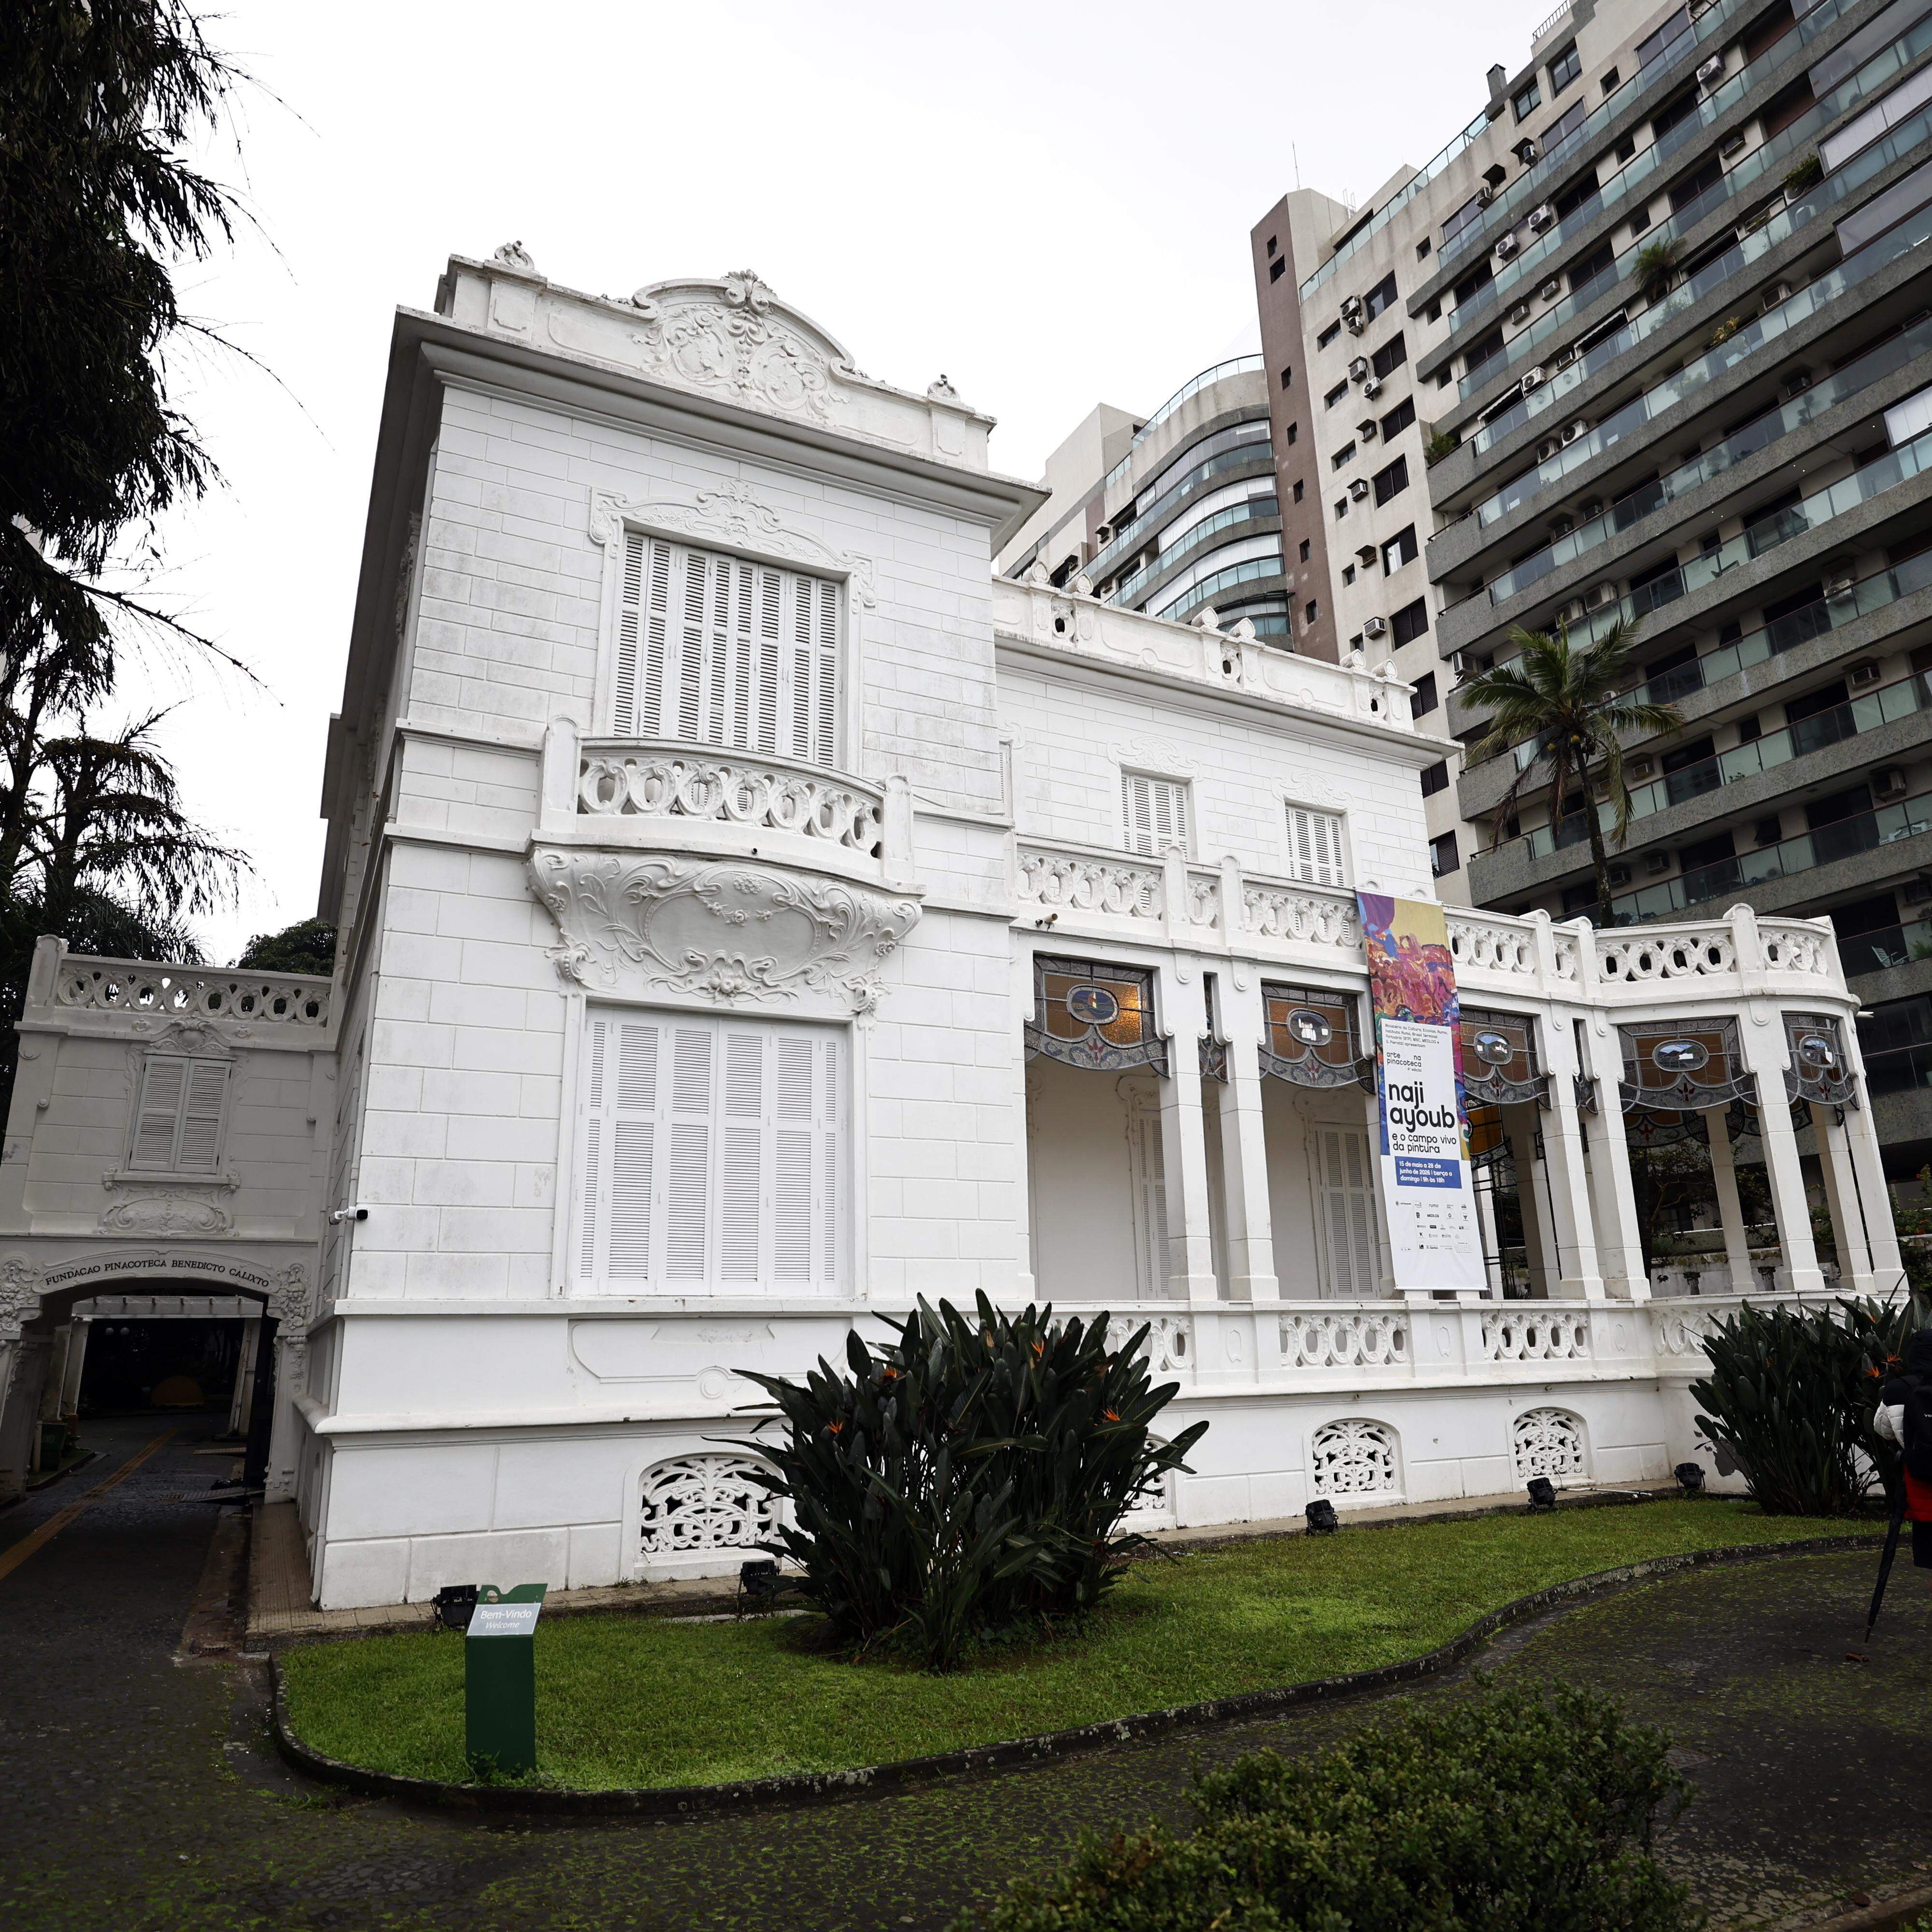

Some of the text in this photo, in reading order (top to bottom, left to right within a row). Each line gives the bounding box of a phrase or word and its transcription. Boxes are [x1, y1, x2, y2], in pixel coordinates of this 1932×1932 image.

[1387, 1058, 1421, 1067] pinacoteca
[1389, 1081, 1424, 1110] naji
[1390, 1105, 1455, 1133] ayoub
[1408, 1135, 1437, 1146] campo
[1440, 1135, 1457, 1145] vivo
[1393, 1141, 1440, 1154] da pintura
[1400, 1175, 1420, 1183] domingo
[104, 1260, 167, 1271] PINACOTECA
[171, 1260, 225, 1273] BENEDICTO
[229, 1268, 269, 1287] CALIXTO
[481, 1609, 532, 1619] Bem-Vindo
